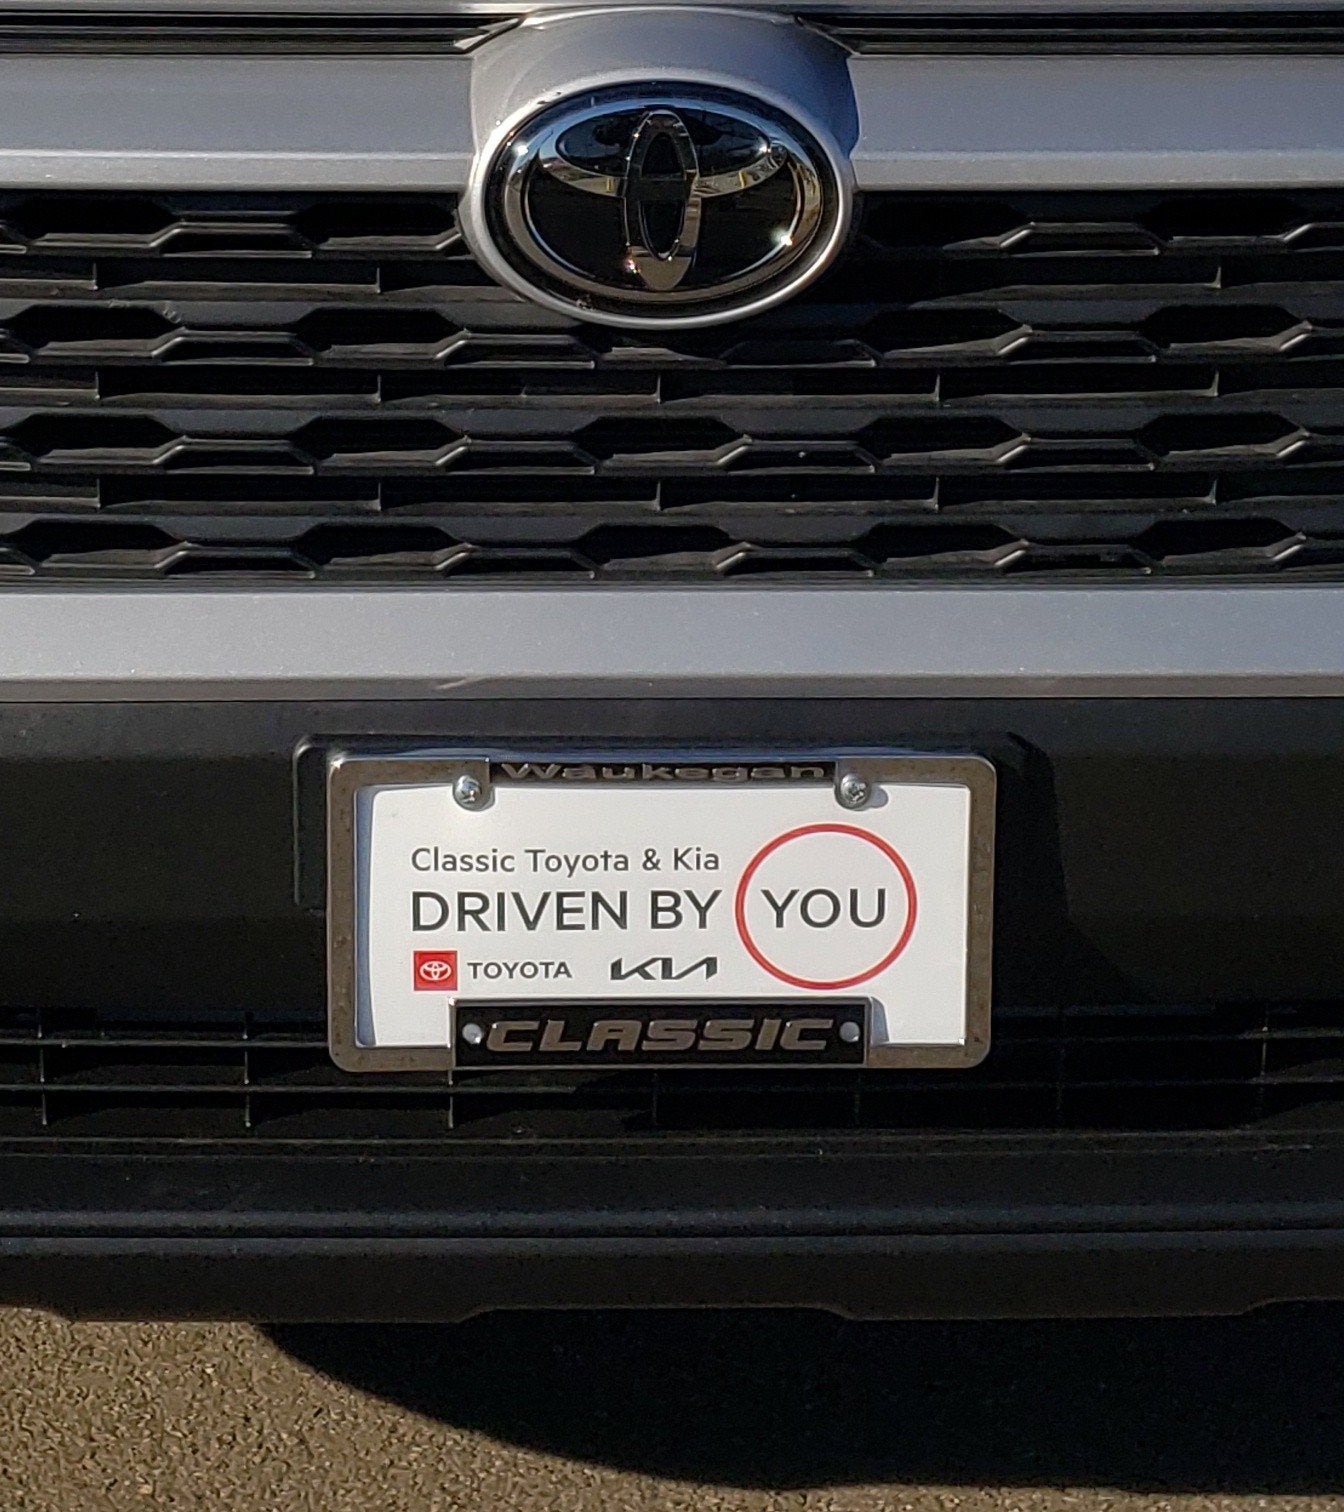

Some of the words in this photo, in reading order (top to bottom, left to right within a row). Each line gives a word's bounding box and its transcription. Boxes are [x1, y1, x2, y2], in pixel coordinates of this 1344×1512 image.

[411, 846, 515, 872] Classic
[523, 848, 629, 877] Toyota
[642, 848, 662, 871] &
[673, 847, 720, 872] Kia
[411, 890, 628, 931] DRIVEN
[649, 890, 722, 929] BY
[761, 888, 887, 928] YOU
[468, 962, 573, 980] TOYOTA
[485, 1019, 834, 1052] CLASSIC
